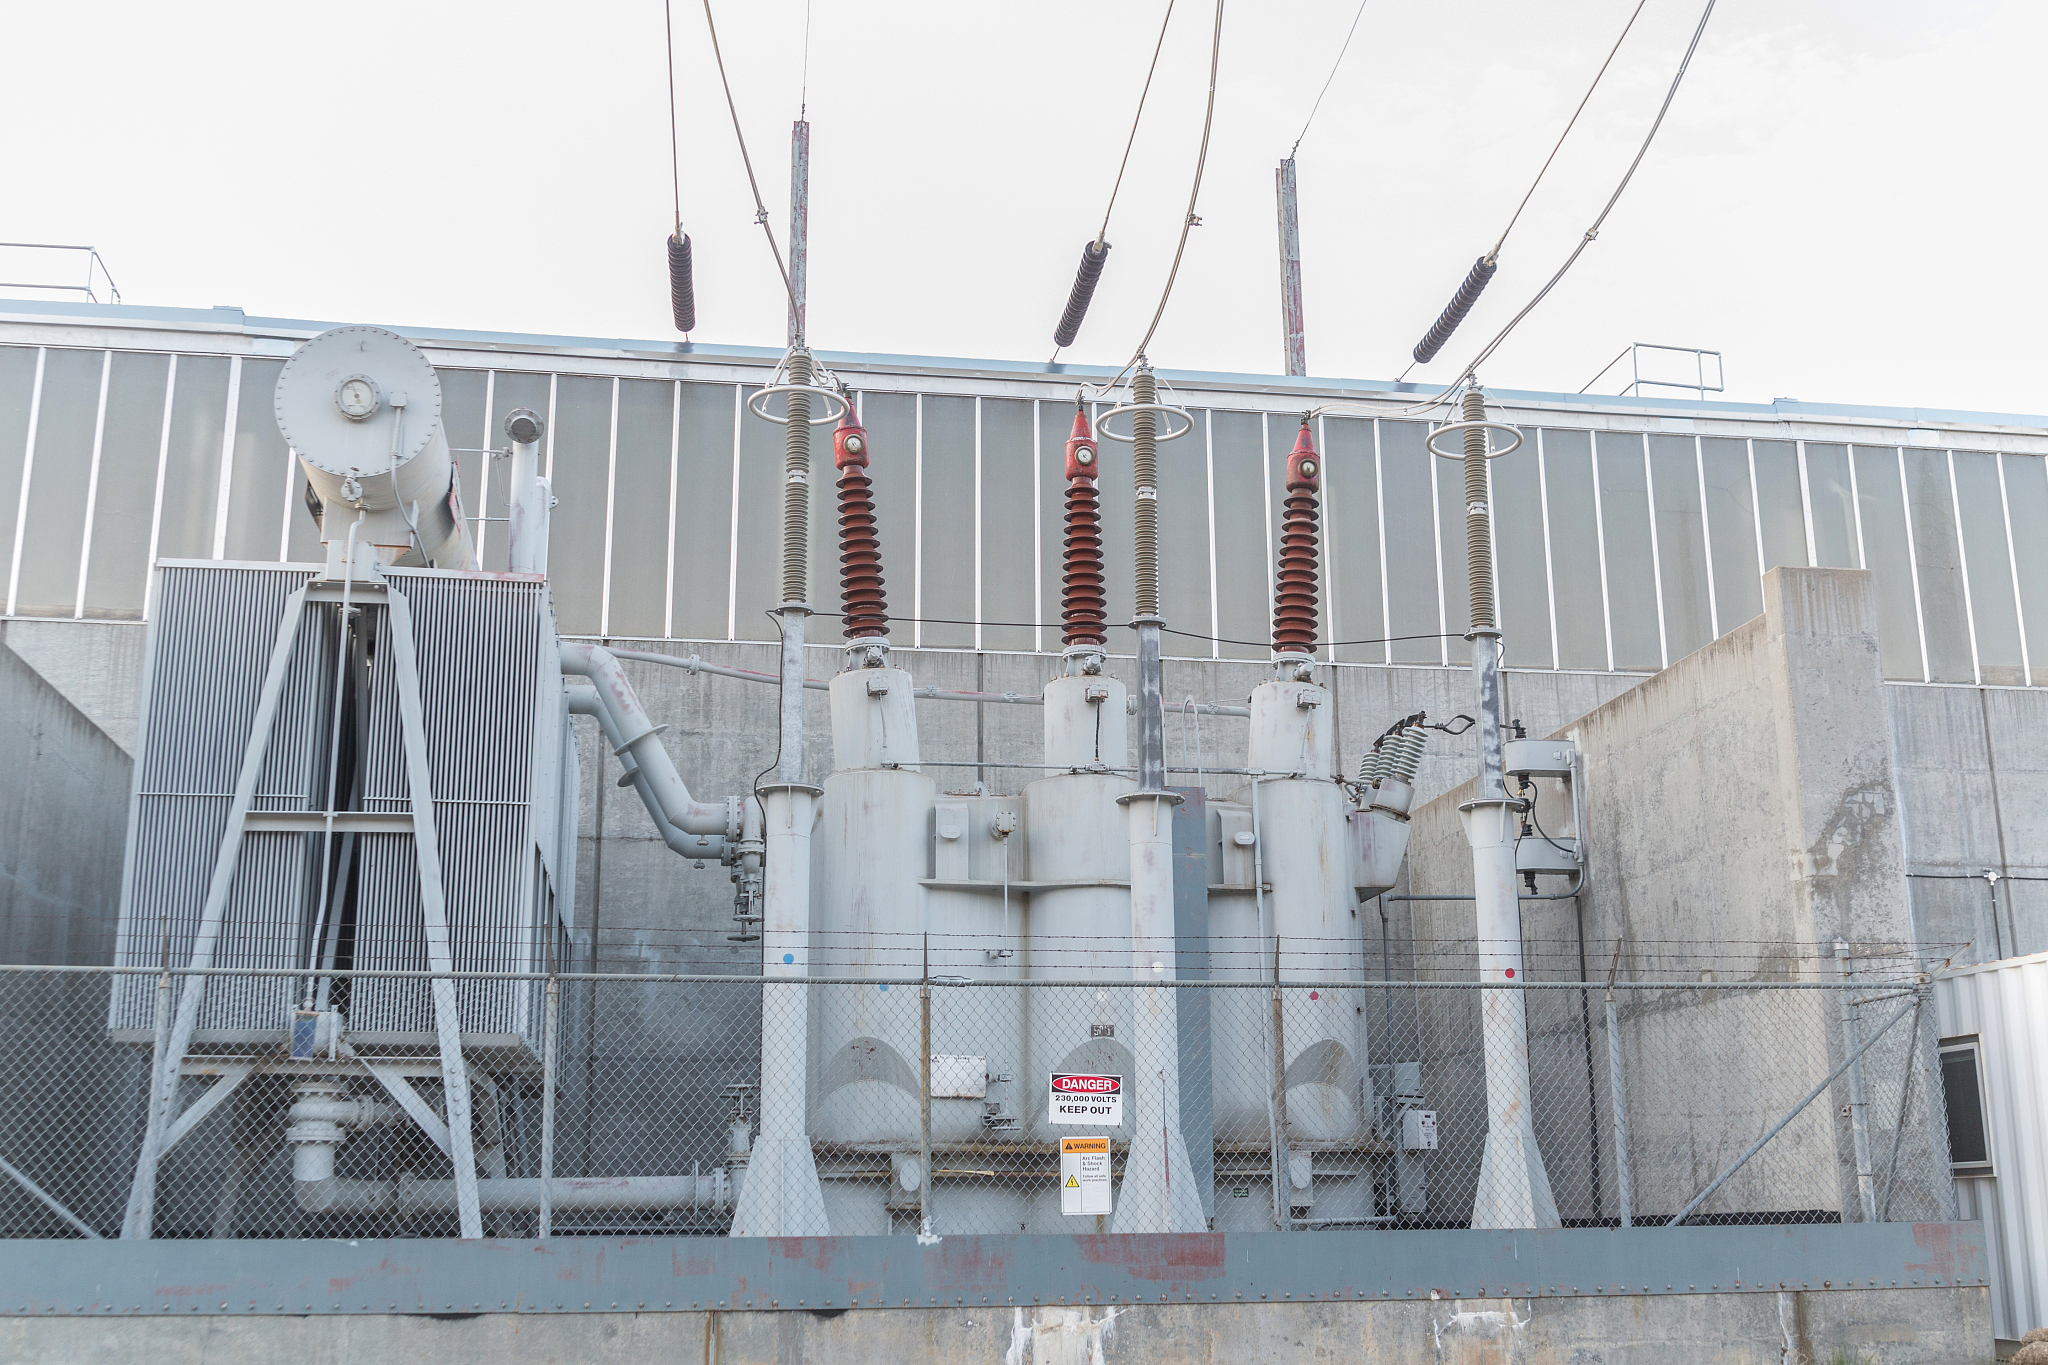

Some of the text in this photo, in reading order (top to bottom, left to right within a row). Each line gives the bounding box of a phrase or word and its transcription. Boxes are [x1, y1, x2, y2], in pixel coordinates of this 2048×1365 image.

[1062, 1078, 1112, 1090] DANGER
[1055, 1095, 1090, 1103] 230,000
[1060, 1106, 1112, 1114] KEEP OUT
